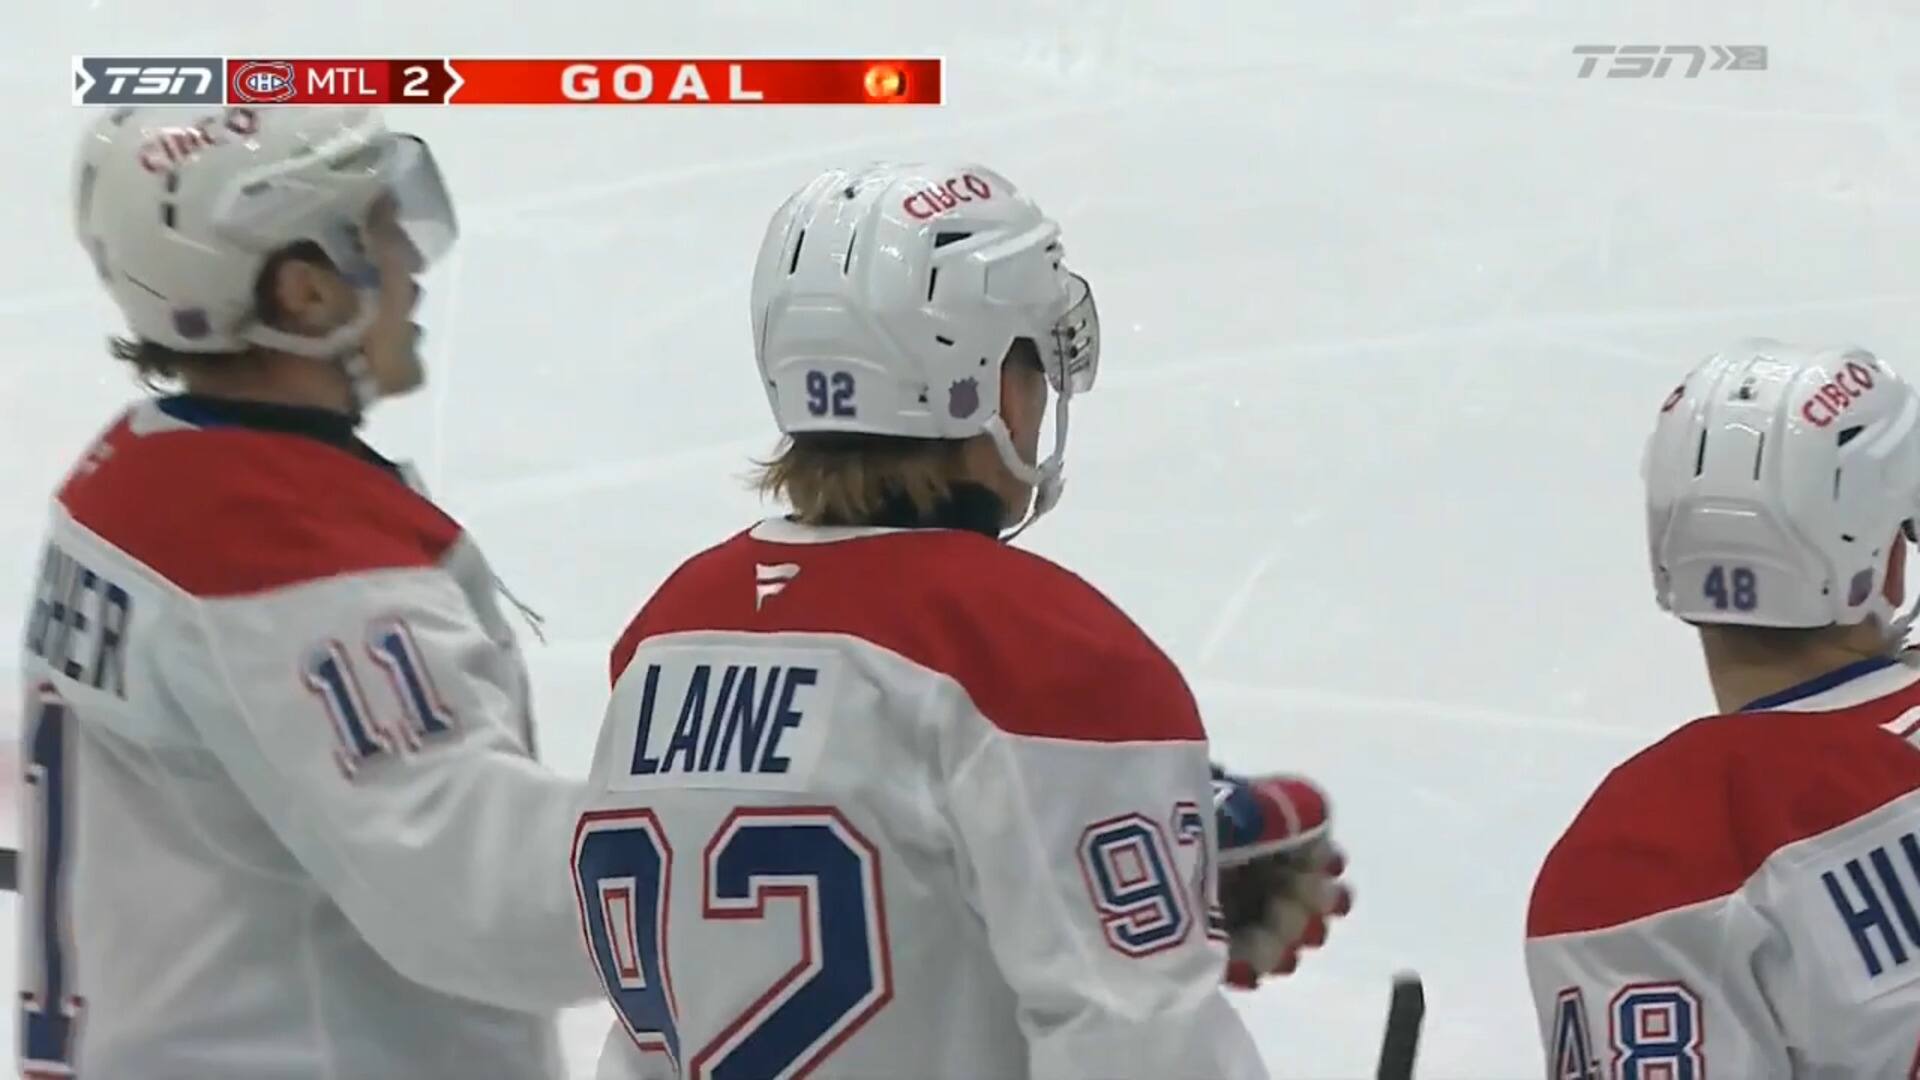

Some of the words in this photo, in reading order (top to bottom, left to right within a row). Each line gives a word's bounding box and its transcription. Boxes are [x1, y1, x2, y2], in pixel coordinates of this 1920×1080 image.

[903, 173, 992, 220] CIBCO
[806, 370, 856, 417] 92
[1802, 361, 1874, 428] CIBCO
[1704, 565, 1757, 611] 48
[305, 616, 456, 781] 11
[629, 664, 819, 775] LAINE
[571, 805, 894, 1080] 92
